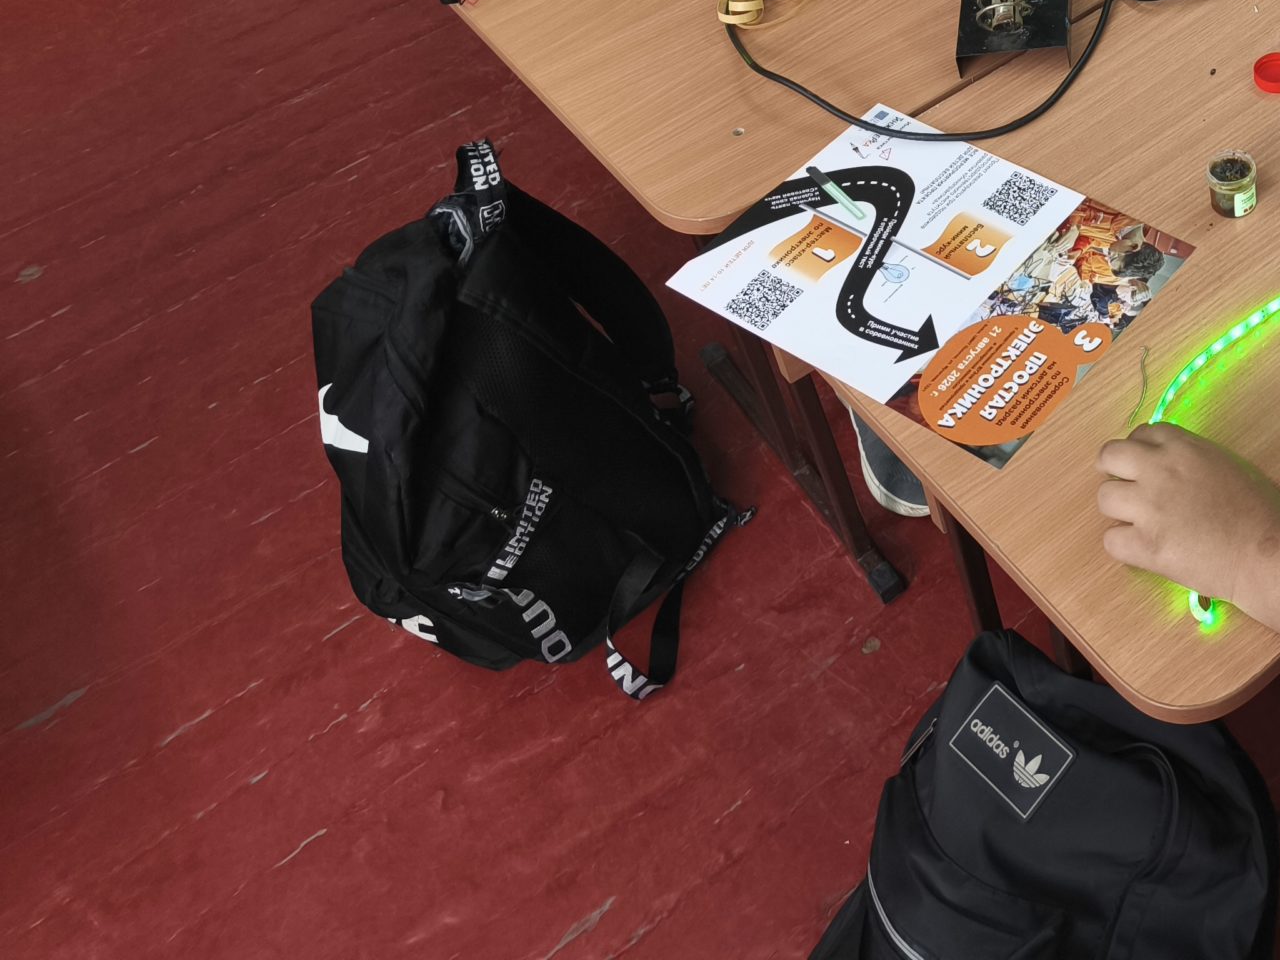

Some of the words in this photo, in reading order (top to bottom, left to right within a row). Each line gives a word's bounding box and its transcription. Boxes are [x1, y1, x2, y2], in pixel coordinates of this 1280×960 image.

[812, 221, 824, 231] по
[880, 218, 898, 240] Пройди
[933, 223, 969, 257] мини-курс
[942, 222, 984, 261] Бесплатный
[784, 224, 832, 268] Мастер-класс
[812, 247, 838, 263] 1
[865, 238, 885, 269] мини-курс
[967, 236, 998, 261] 2
[864, 327, 919, 350] соревнованиях
[866, 320, 891, 334] Прими
[890, 327, 920, 342] участие
[987, 324, 1002, 338] 21
[1071, 329, 1103, 356] 3
[955, 335, 990, 371] августа
[1045, 359, 1057, 372] на
[935, 318, 1044, 430] ЭЛЕКТРОНИКА
[977, 349, 1048, 423] ПРОСТАЯ
[1019, 369, 1049, 401] детский
[1049, 368, 1061, 381] по
[994, 398, 1021, 427] разряд
[1008, 379, 1052, 427] электронике
[1018, 374, 1070, 430] Соревнования
[494, 479, 544, 566] LIMITED
[504, 484, 554, 568] EDITION
[970, 718, 1009, 759] adidas
